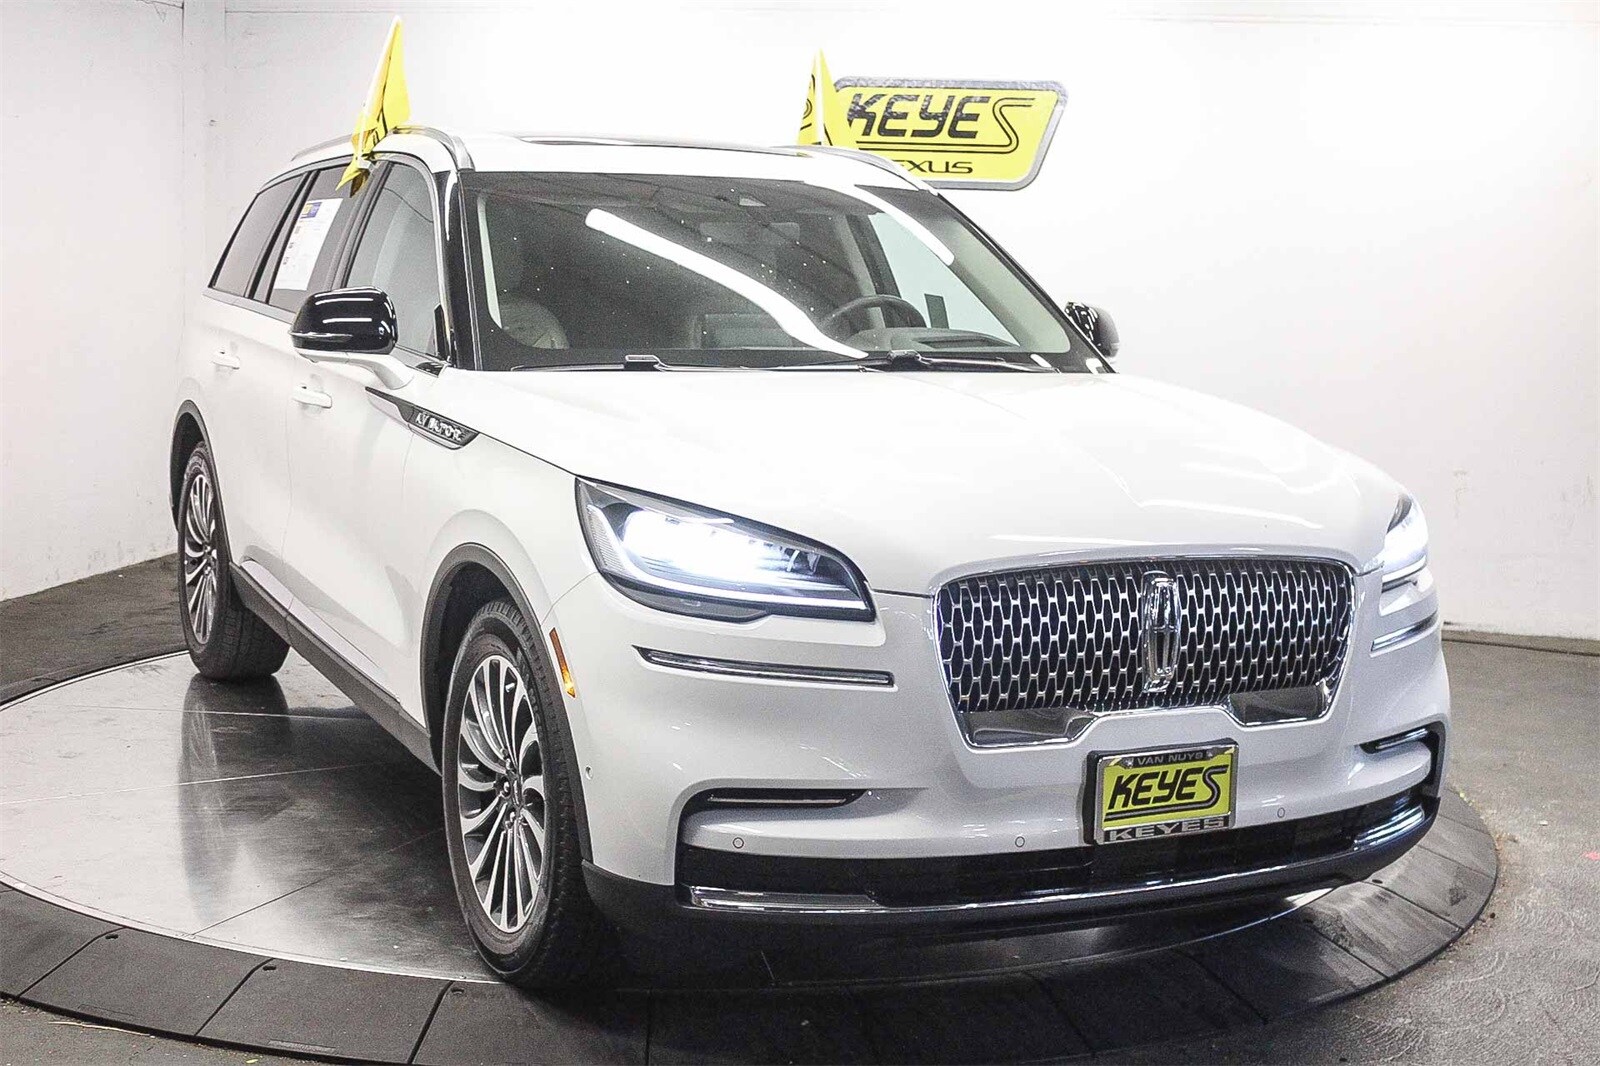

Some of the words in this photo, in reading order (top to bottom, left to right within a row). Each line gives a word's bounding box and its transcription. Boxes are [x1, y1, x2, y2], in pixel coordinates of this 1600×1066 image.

[847, 93, 1036, 154] KEYES
[1138, 756, 1164, 765] VAN
[1168, 751, 1204, 762] NUYS
[1104, 764, 1230, 822] KEYES
[1109, 817, 1225, 841] KEYES
